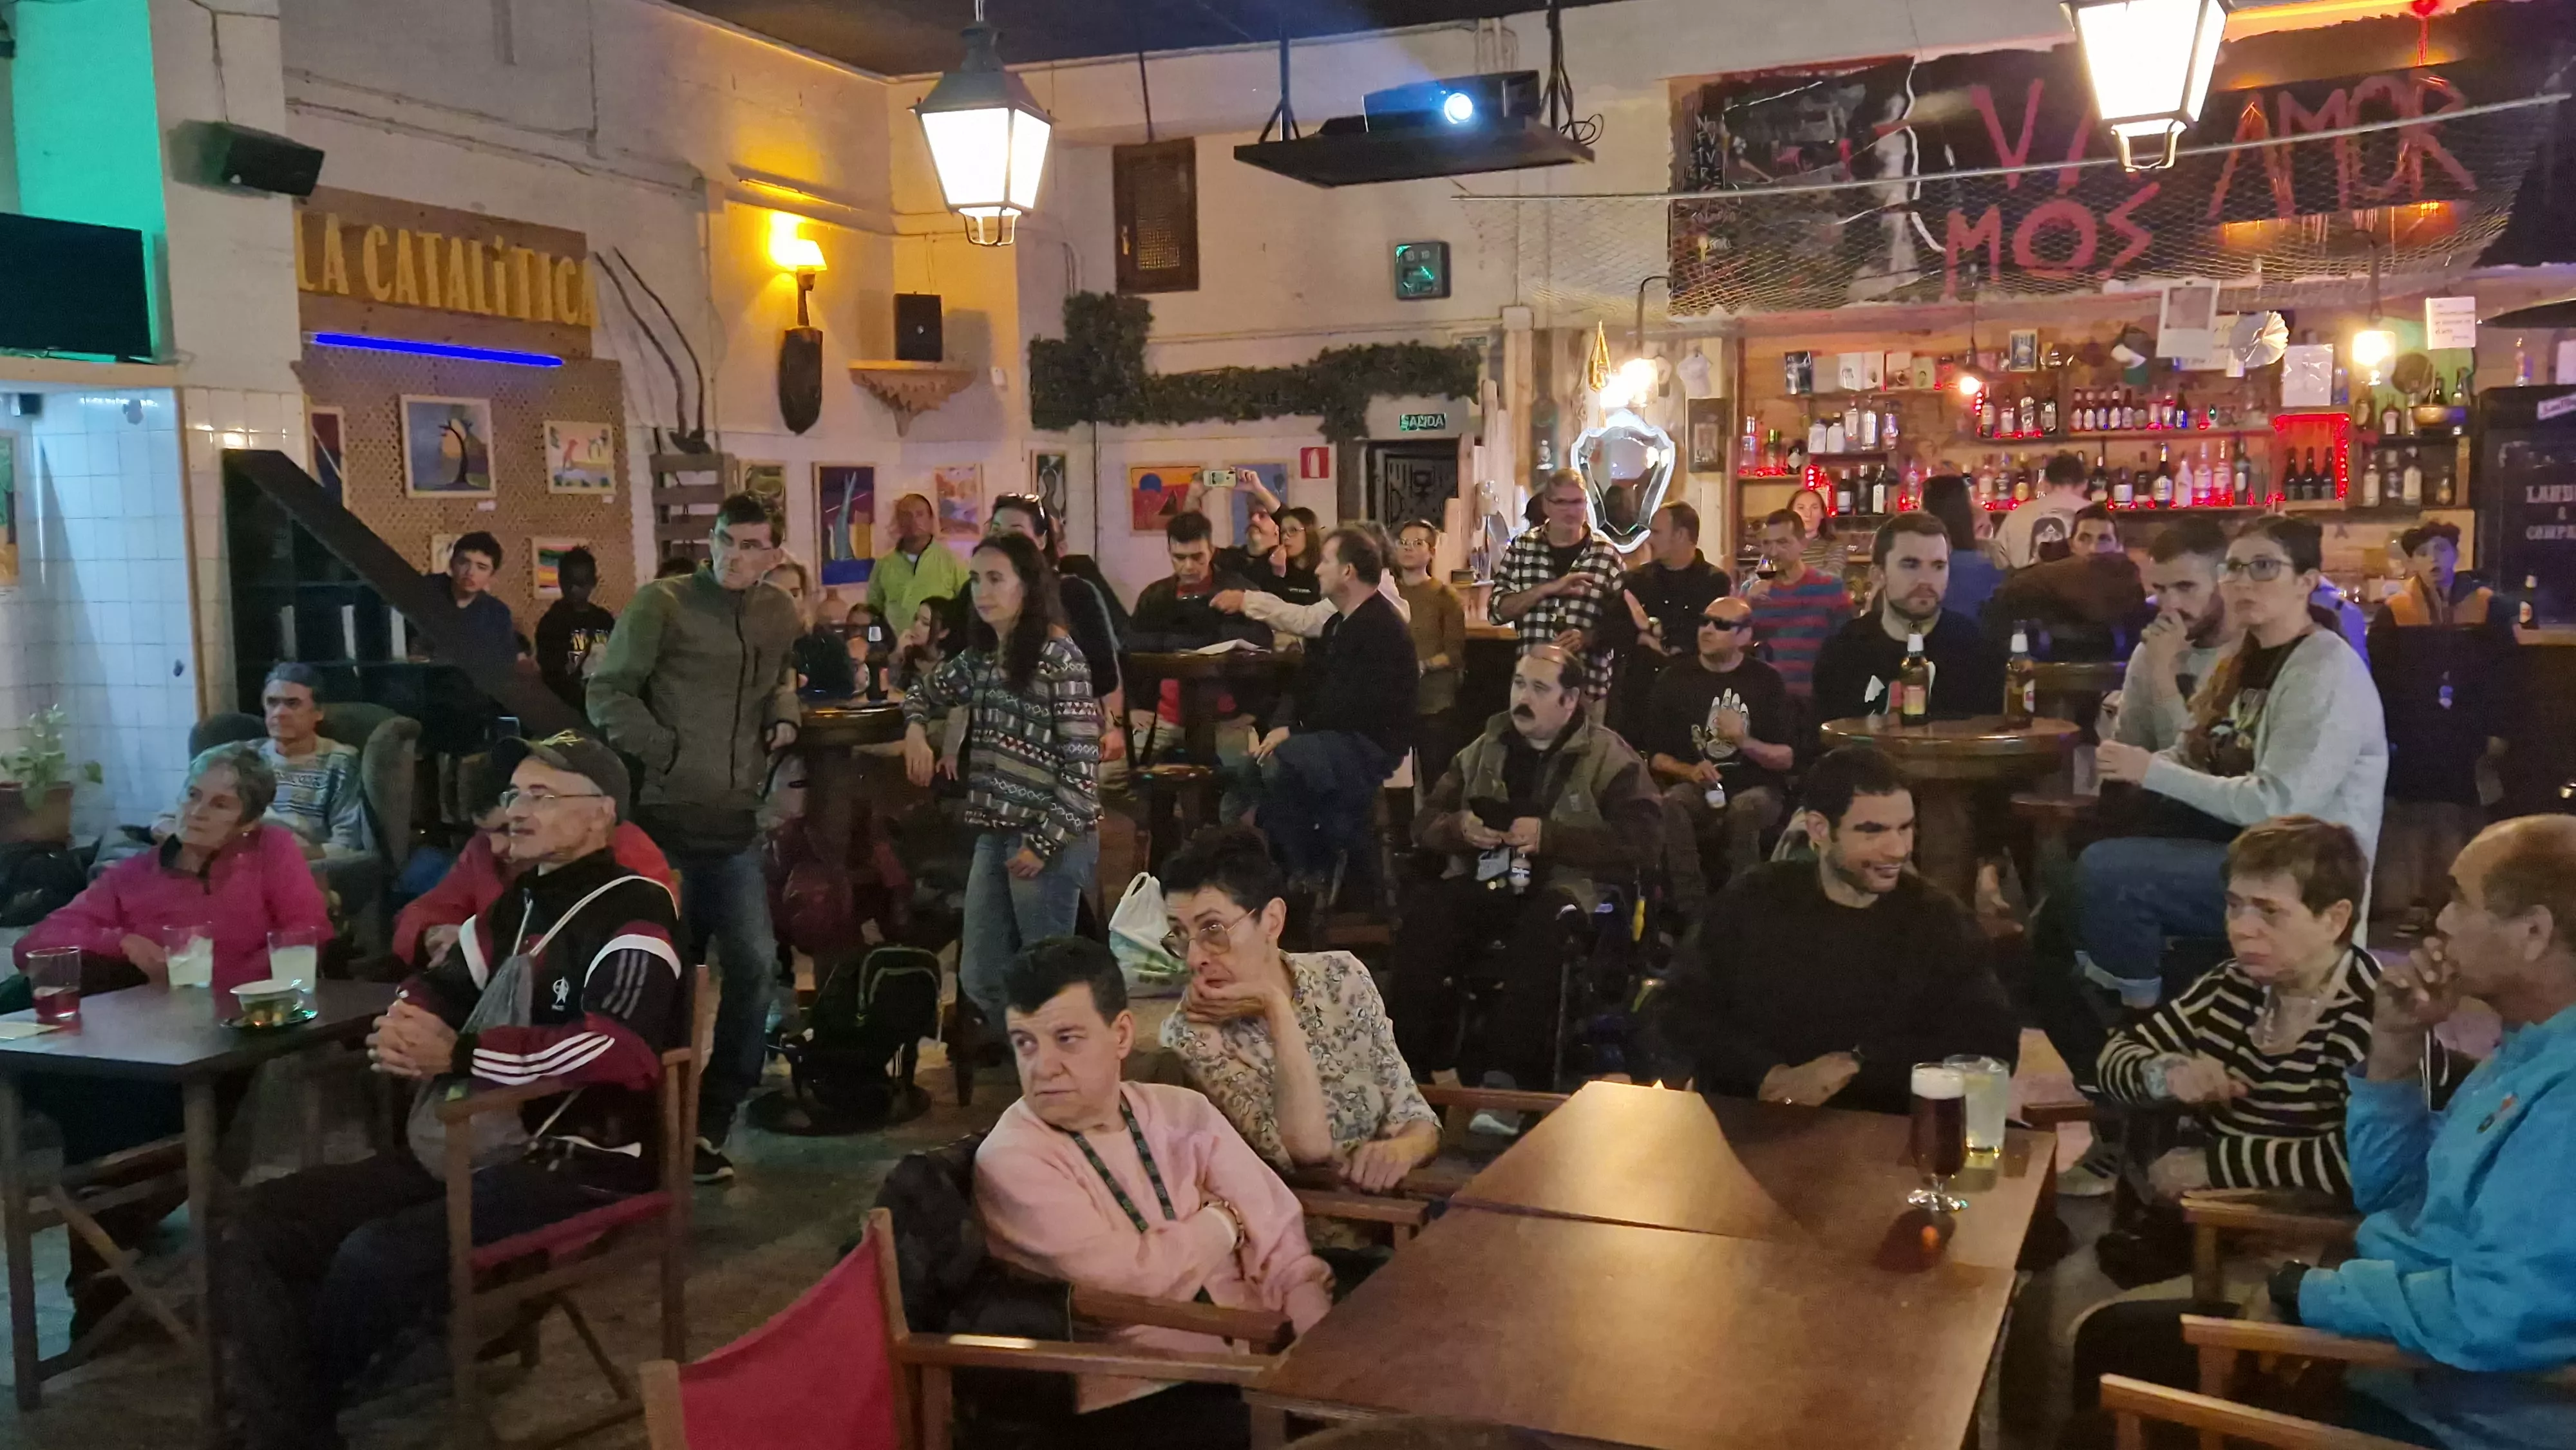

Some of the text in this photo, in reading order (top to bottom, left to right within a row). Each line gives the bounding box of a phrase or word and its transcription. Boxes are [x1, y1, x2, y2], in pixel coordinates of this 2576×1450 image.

[2206, 68, 2478, 219] AMOR
[294, 210, 350, 295] LA
[1944, 181, 2161, 299] MOS
